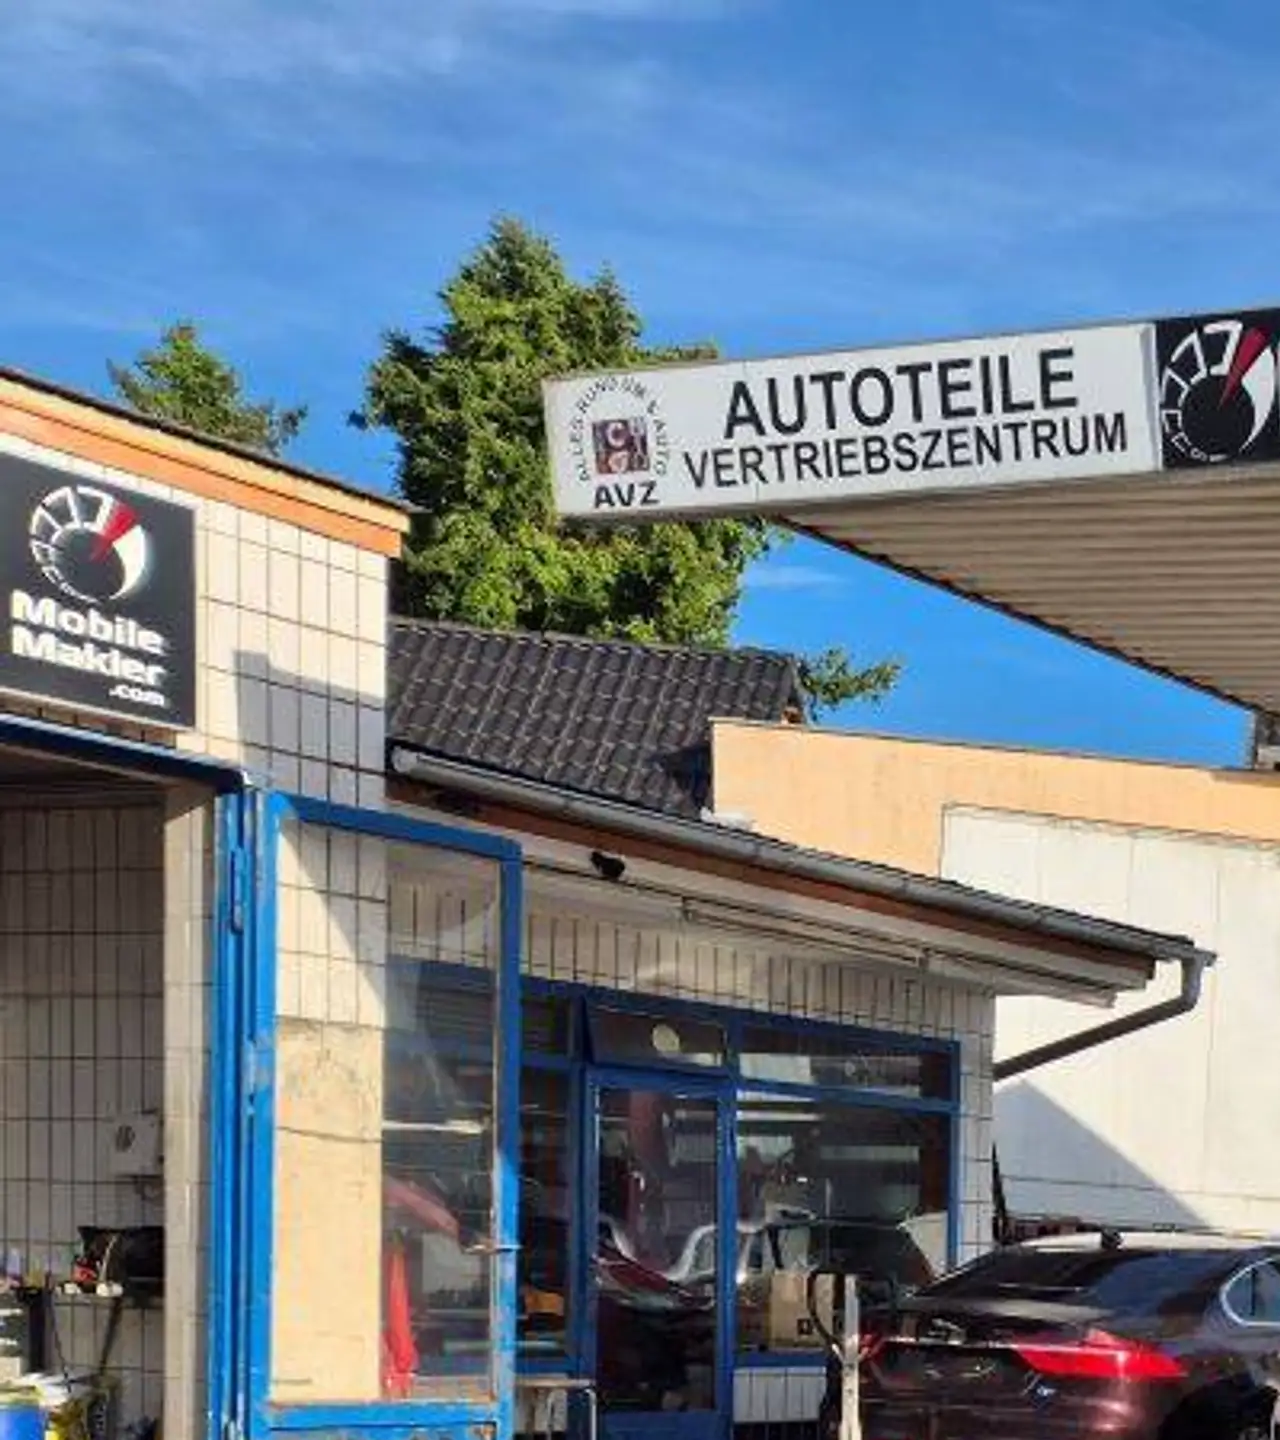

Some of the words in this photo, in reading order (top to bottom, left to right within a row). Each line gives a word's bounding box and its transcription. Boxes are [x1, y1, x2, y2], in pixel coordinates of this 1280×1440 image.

[724, 347, 1078, 439] AUTOTEILE
[683, 412, 1128, 489] VERTRIEBSZENTRUM
[594, 480, 660, 508] AVZ
[11, 588, 166, 656] Mobile
[11, 624, 167, 686] Makler
